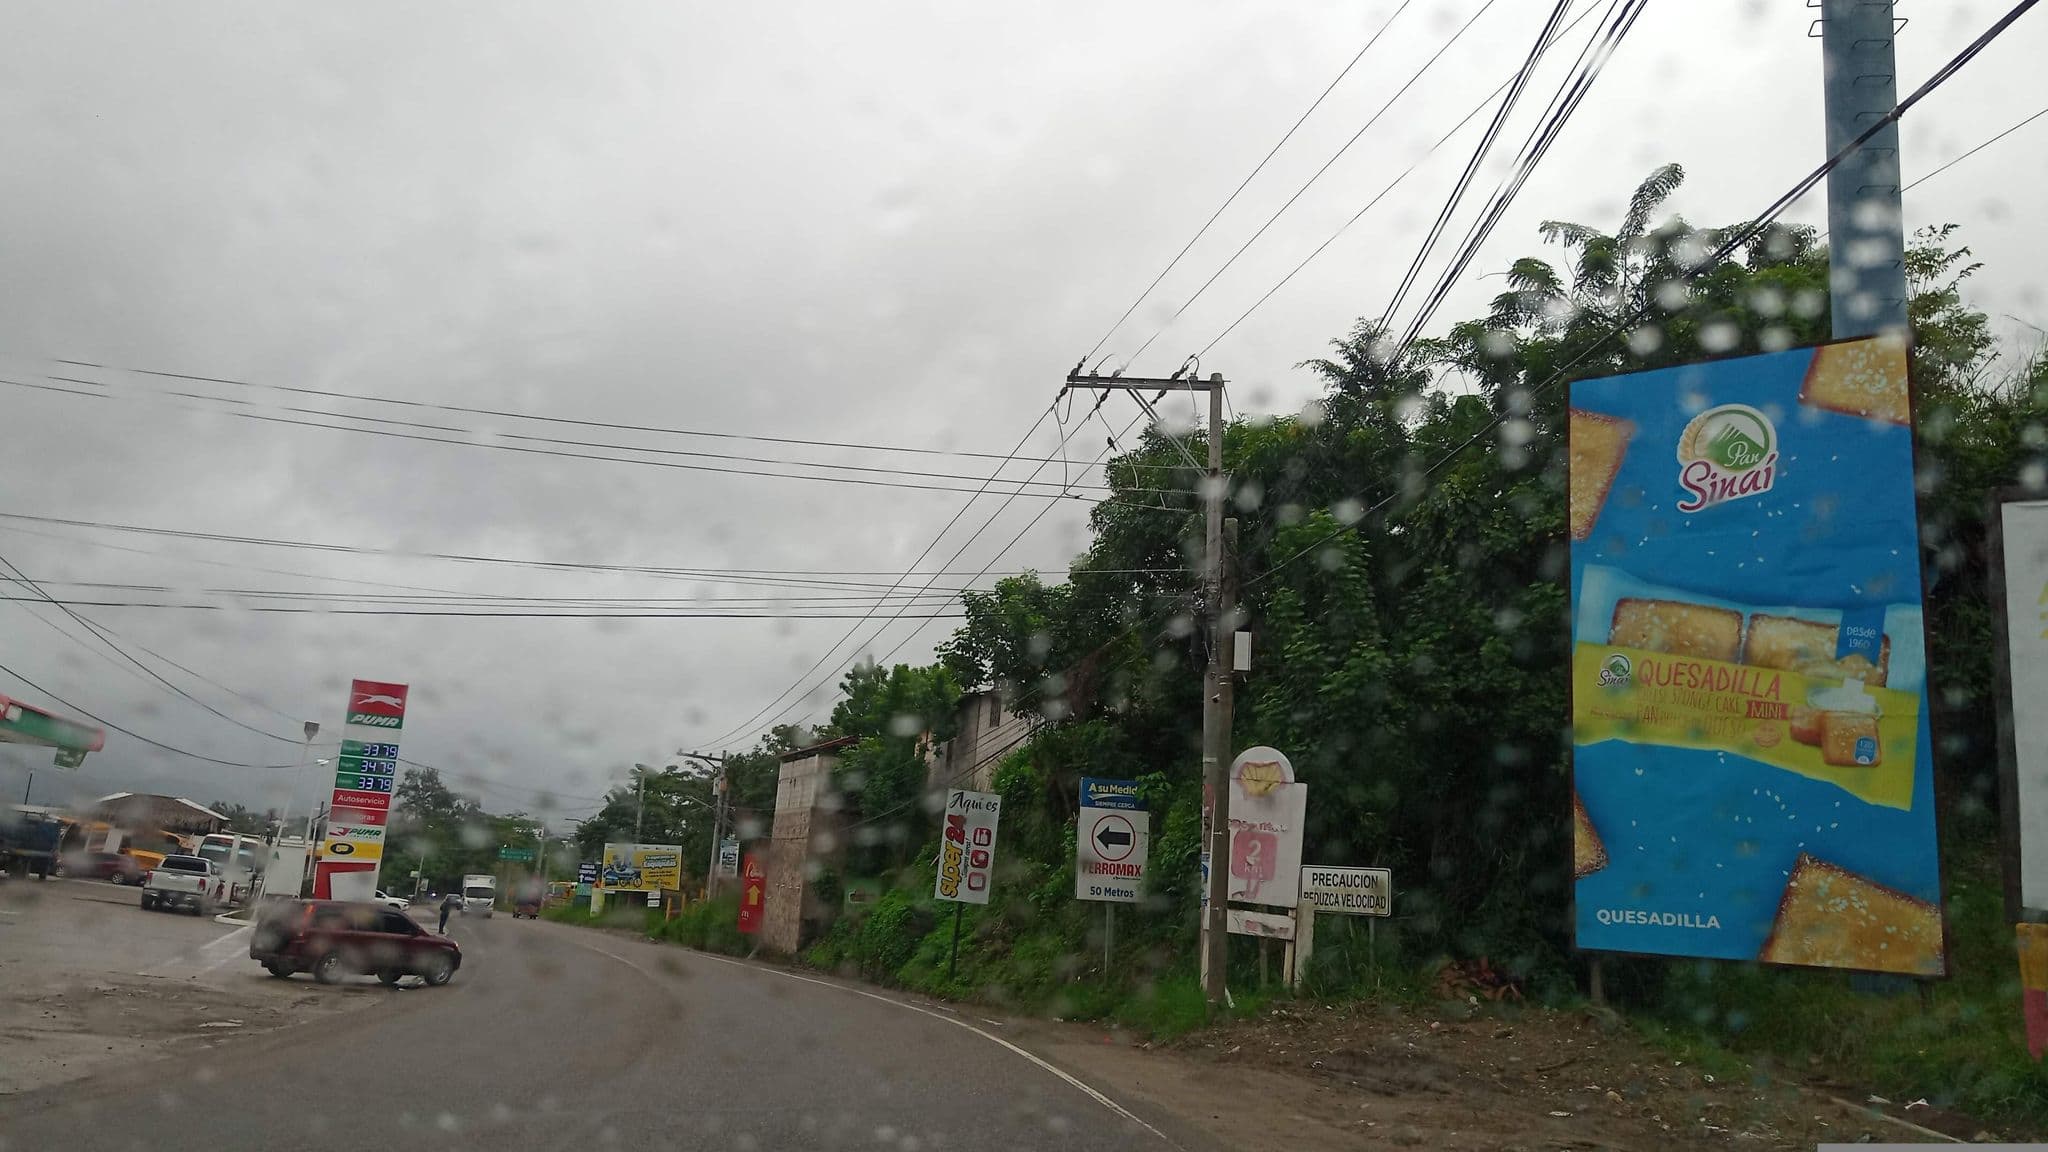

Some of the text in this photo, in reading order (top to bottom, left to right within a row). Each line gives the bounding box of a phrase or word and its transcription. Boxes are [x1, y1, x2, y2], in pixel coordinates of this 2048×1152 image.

[1725, 441, 1760, 467] Pan
[1680, 453, 1776, 511] Sinaí
[1637, 658, 1781, 700] QUESADILLA
[1749, 703, 1784, 719] MINI
[351, 713, 400, 727] PUMA
[1088, 782, 1137, 795] A su Medid
[337, 794, 385, 805] Autoservicio
[985, 800, 999, 813] es
[348, 827, 382, 836] PUMA
[1312, 873, 1379, 889] PRECAUCION
[1090, 886, 1135, 898] 50 Metros
[1341, 893, 1387, 910] VELOCIDAD
[1596, 909, 1721, 929] QUESADILLA
